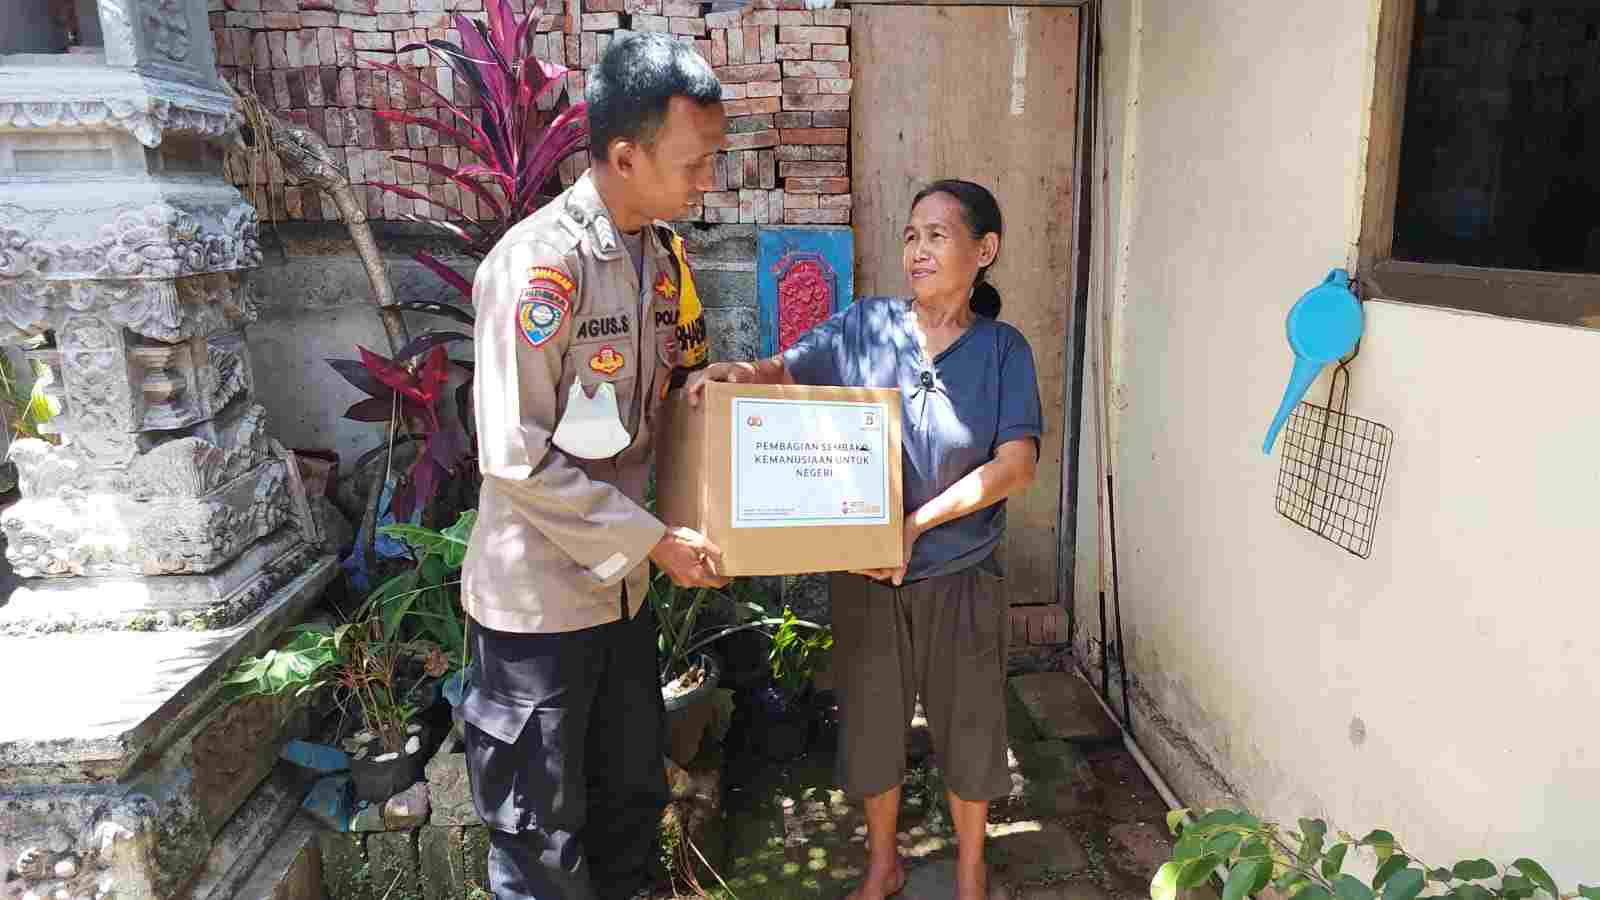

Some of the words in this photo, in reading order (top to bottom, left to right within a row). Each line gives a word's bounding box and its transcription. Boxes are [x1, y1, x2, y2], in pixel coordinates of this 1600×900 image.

[577, 315, 629, 338] AGUS.S
[755, 441, 818, 451] PEMBAGIAN
[754, 455, 833, 465] KEMANUSIAAN
[835, 455, 870, 465] UNTUK
[795, 468, 833, 478] NEGERI
